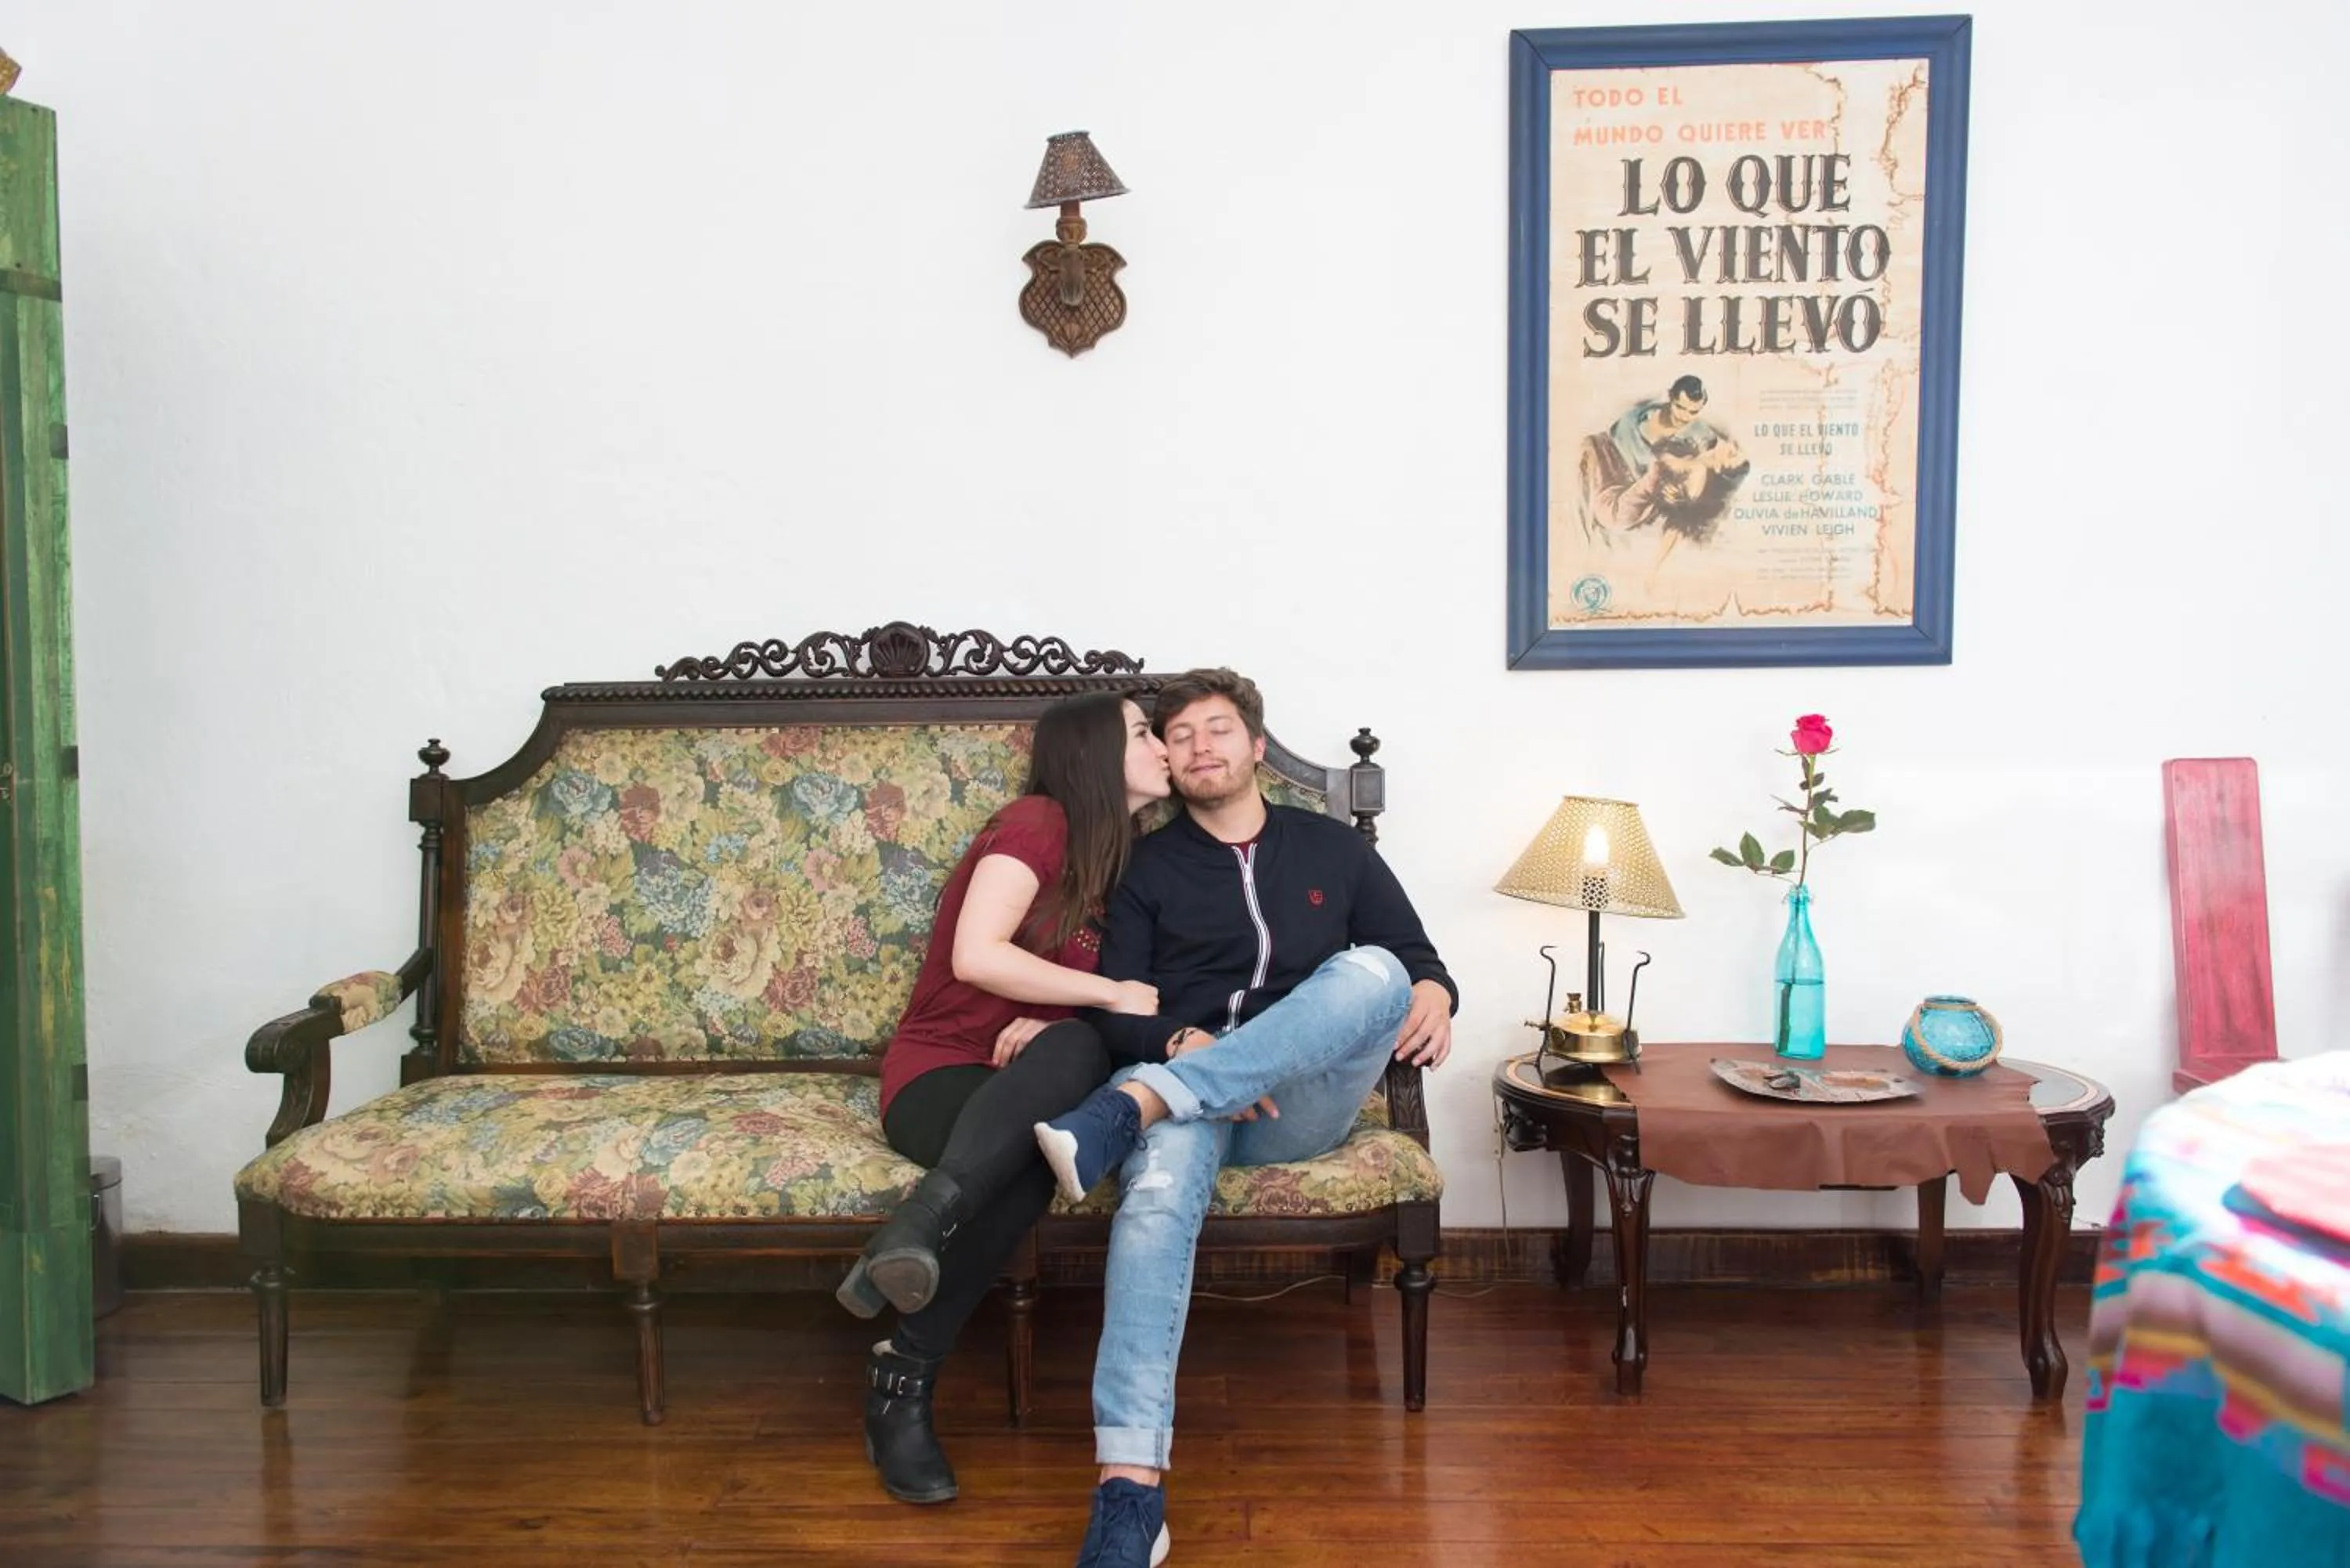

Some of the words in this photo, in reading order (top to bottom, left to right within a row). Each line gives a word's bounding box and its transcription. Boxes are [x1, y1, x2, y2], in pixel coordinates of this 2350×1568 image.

[1574, 89, 1643, 107] TODO
[1658, 87, 1683, 105] EL
[1574, 125, 1664, 146] MUNDO
[1678, 123, 1766, 142] QUIERE
[1781, 121, 1826, 139] VER
[1617, 157, 1706, 217] LO
[1726, 154, 1851, 218] QUE
[1574, 228, 1651, 288] EL
[1667, 224, 1891, 284] VIENTO
[1583, 297, 1658, 358] SE
[1679, 288, 1882, 356] LLEVÓ
[1754, 425, 1768, 437] LO
[1773, 424, 1796, 437] QUE
[1801, 424, 1813, 436] EL
[1818, 423, 1859, 436] VIENTO
[1780, 443, 1794, 455] SE
[1761, 474, 1804, 486] CLARK
[1812, 473, 1856, 486] GABLE
[1752, 491, 1791, 503] LESLIE
[1799, 490, 1863, 503] HOWARD
[1734, 508, 1779, 519] OLIVIA
[1762, 525, 1808, 536] VIVIEN
[1816, 523, 1855, 536] LEIGH
